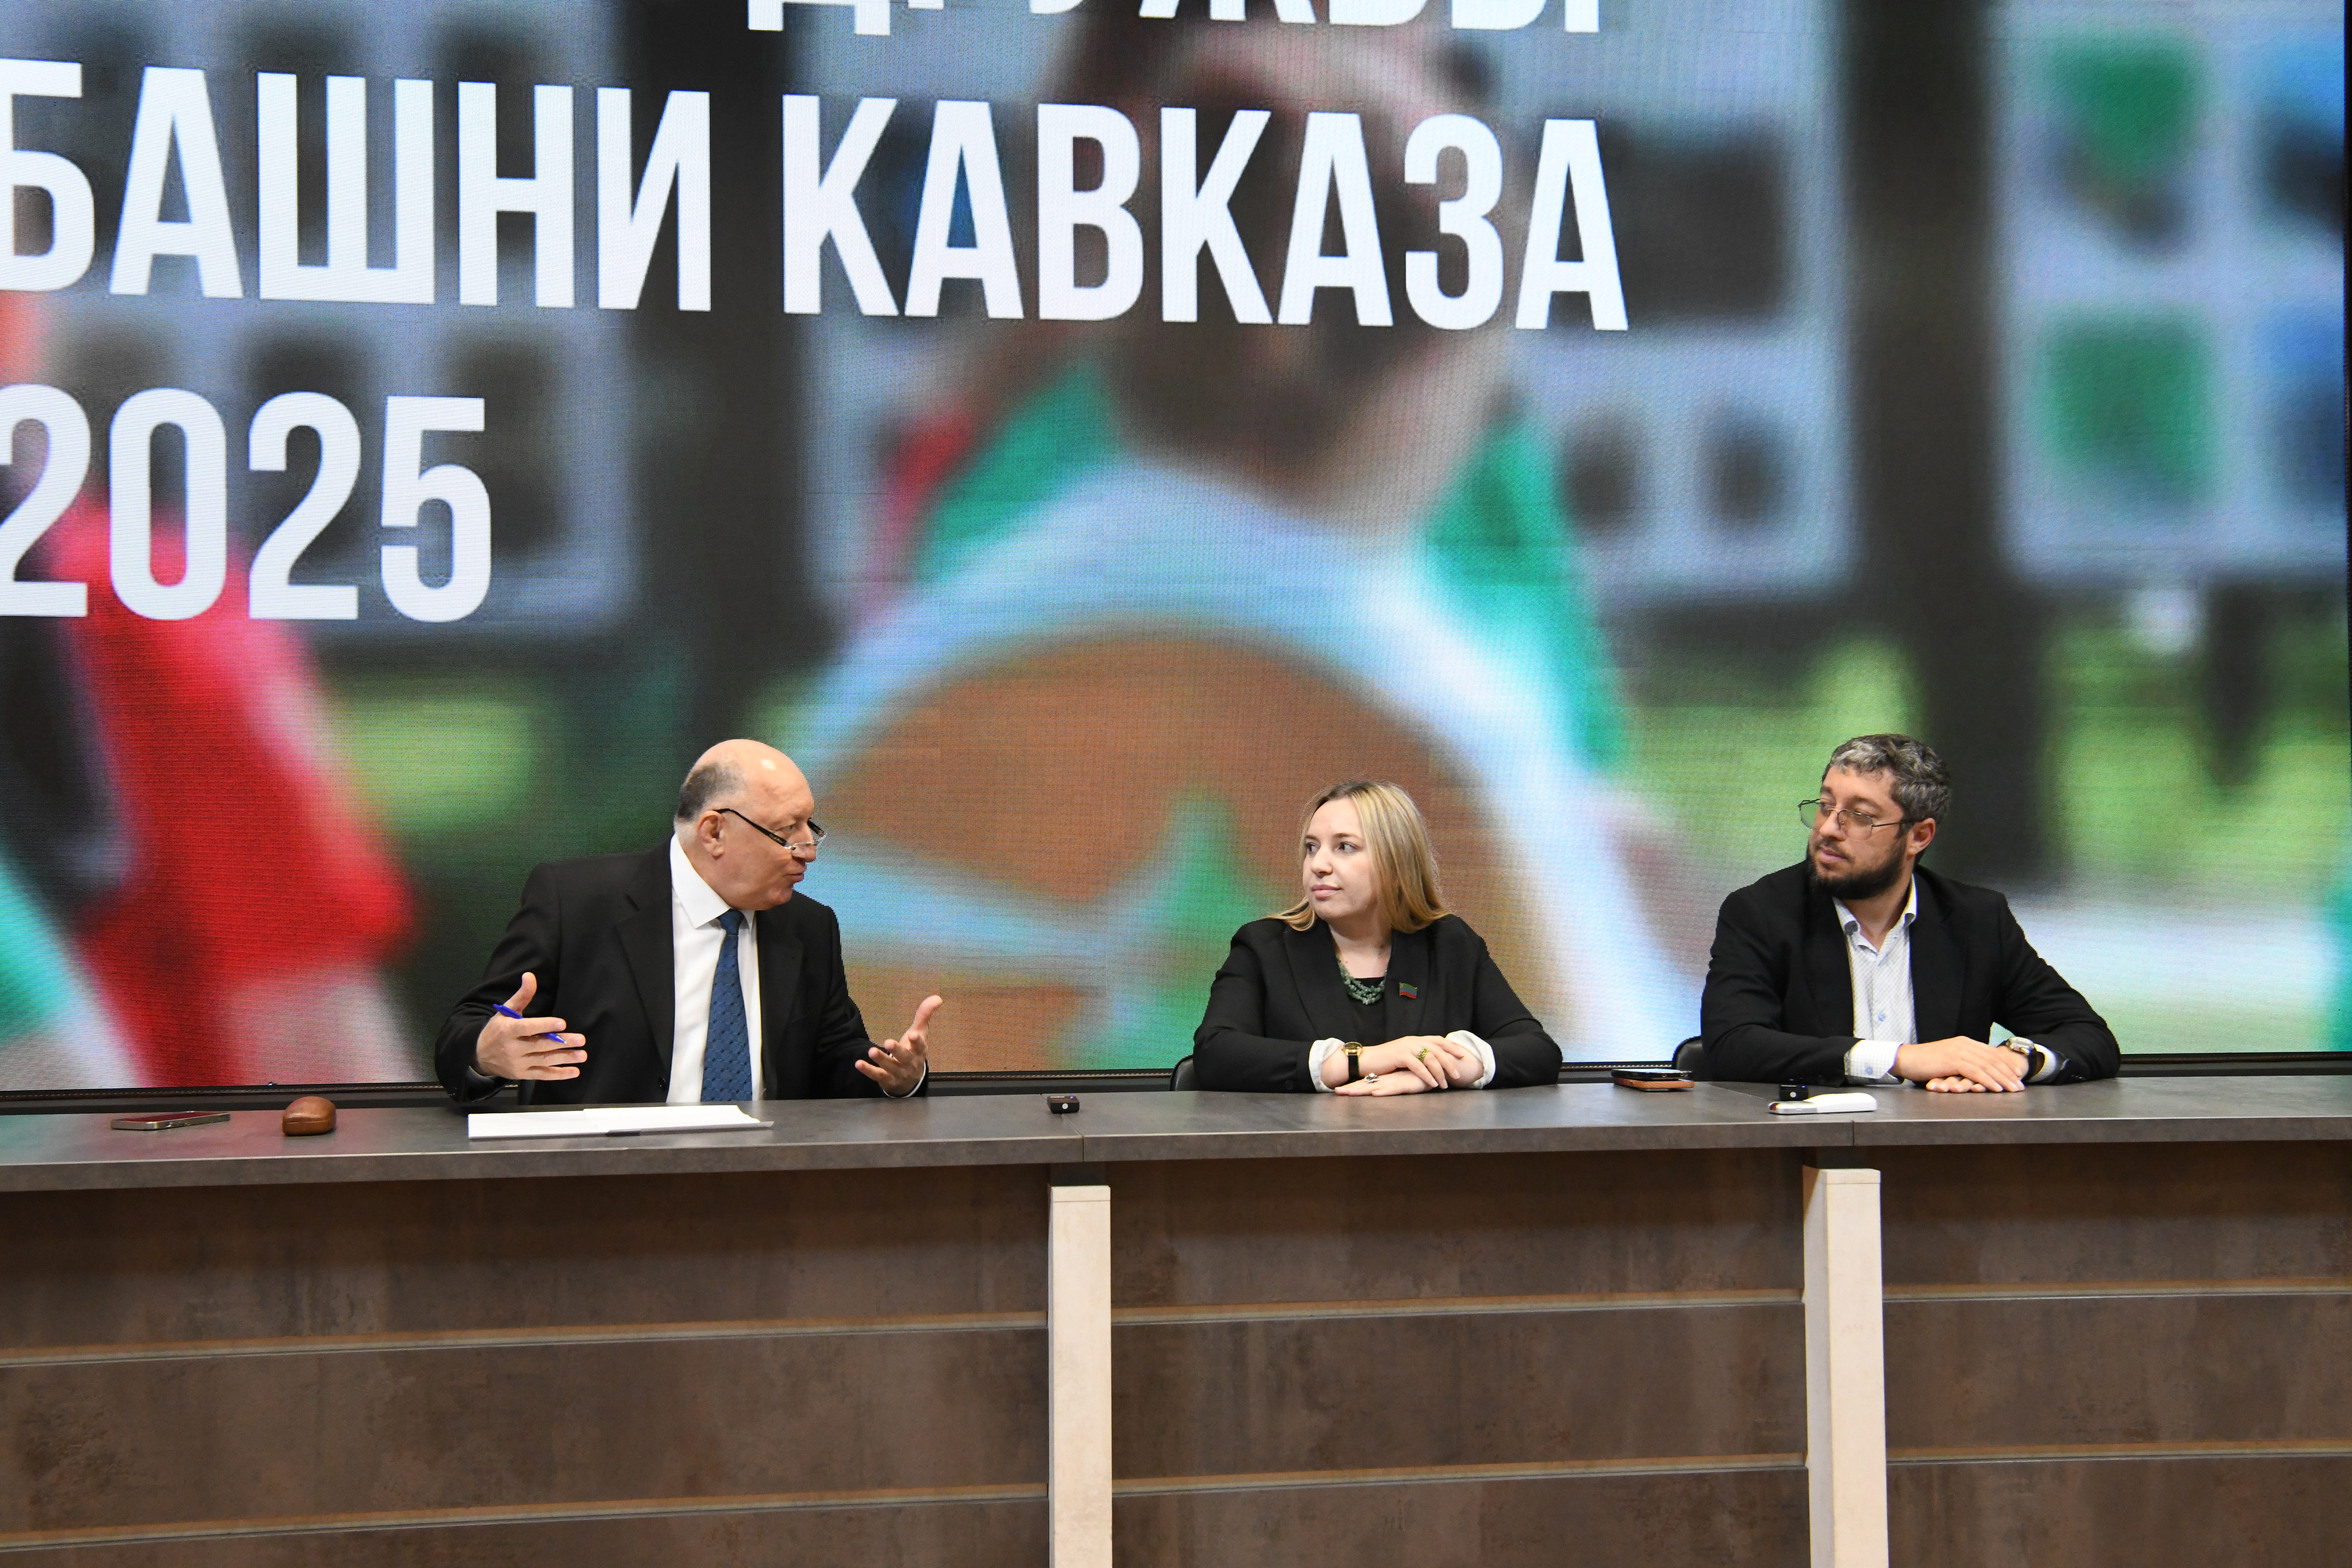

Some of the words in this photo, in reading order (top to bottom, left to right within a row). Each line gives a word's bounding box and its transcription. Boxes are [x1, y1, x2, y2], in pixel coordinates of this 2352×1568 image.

[0, 58, 711, 311] БАШНИ
[783, 94, 1628, 332] КАВКАЗА
[0, 383, 492, 622] 2025
